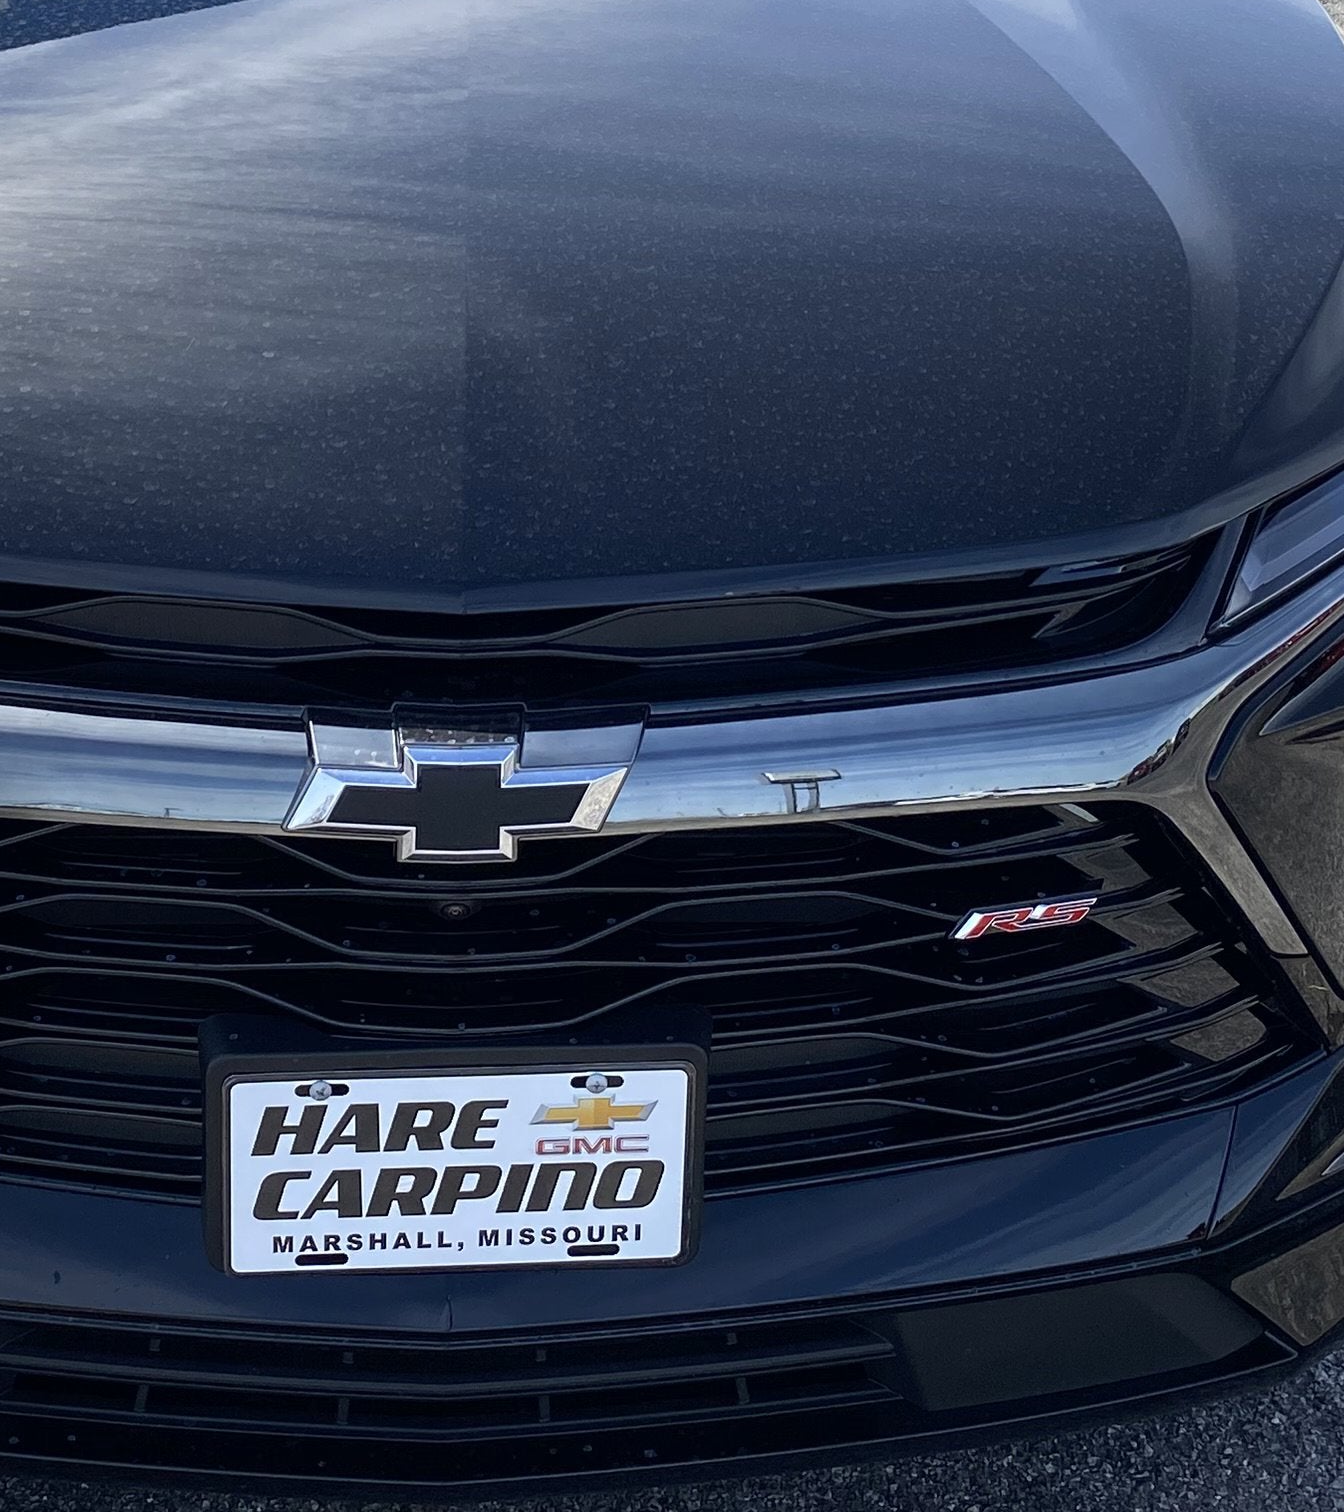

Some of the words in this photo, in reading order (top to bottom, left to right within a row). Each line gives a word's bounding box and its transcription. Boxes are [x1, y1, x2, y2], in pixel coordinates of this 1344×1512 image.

[954, 897, 1098, 940] RS
[250, 1099, 510, 1157] HARE
[534, 1133, 650, 1157] GMC
[252, 1159, 666, 1221] CARPINO
[272, 1230, 464, 1254] MARSHALL,
[478, 1224, 643, 1247] MISSOURI
